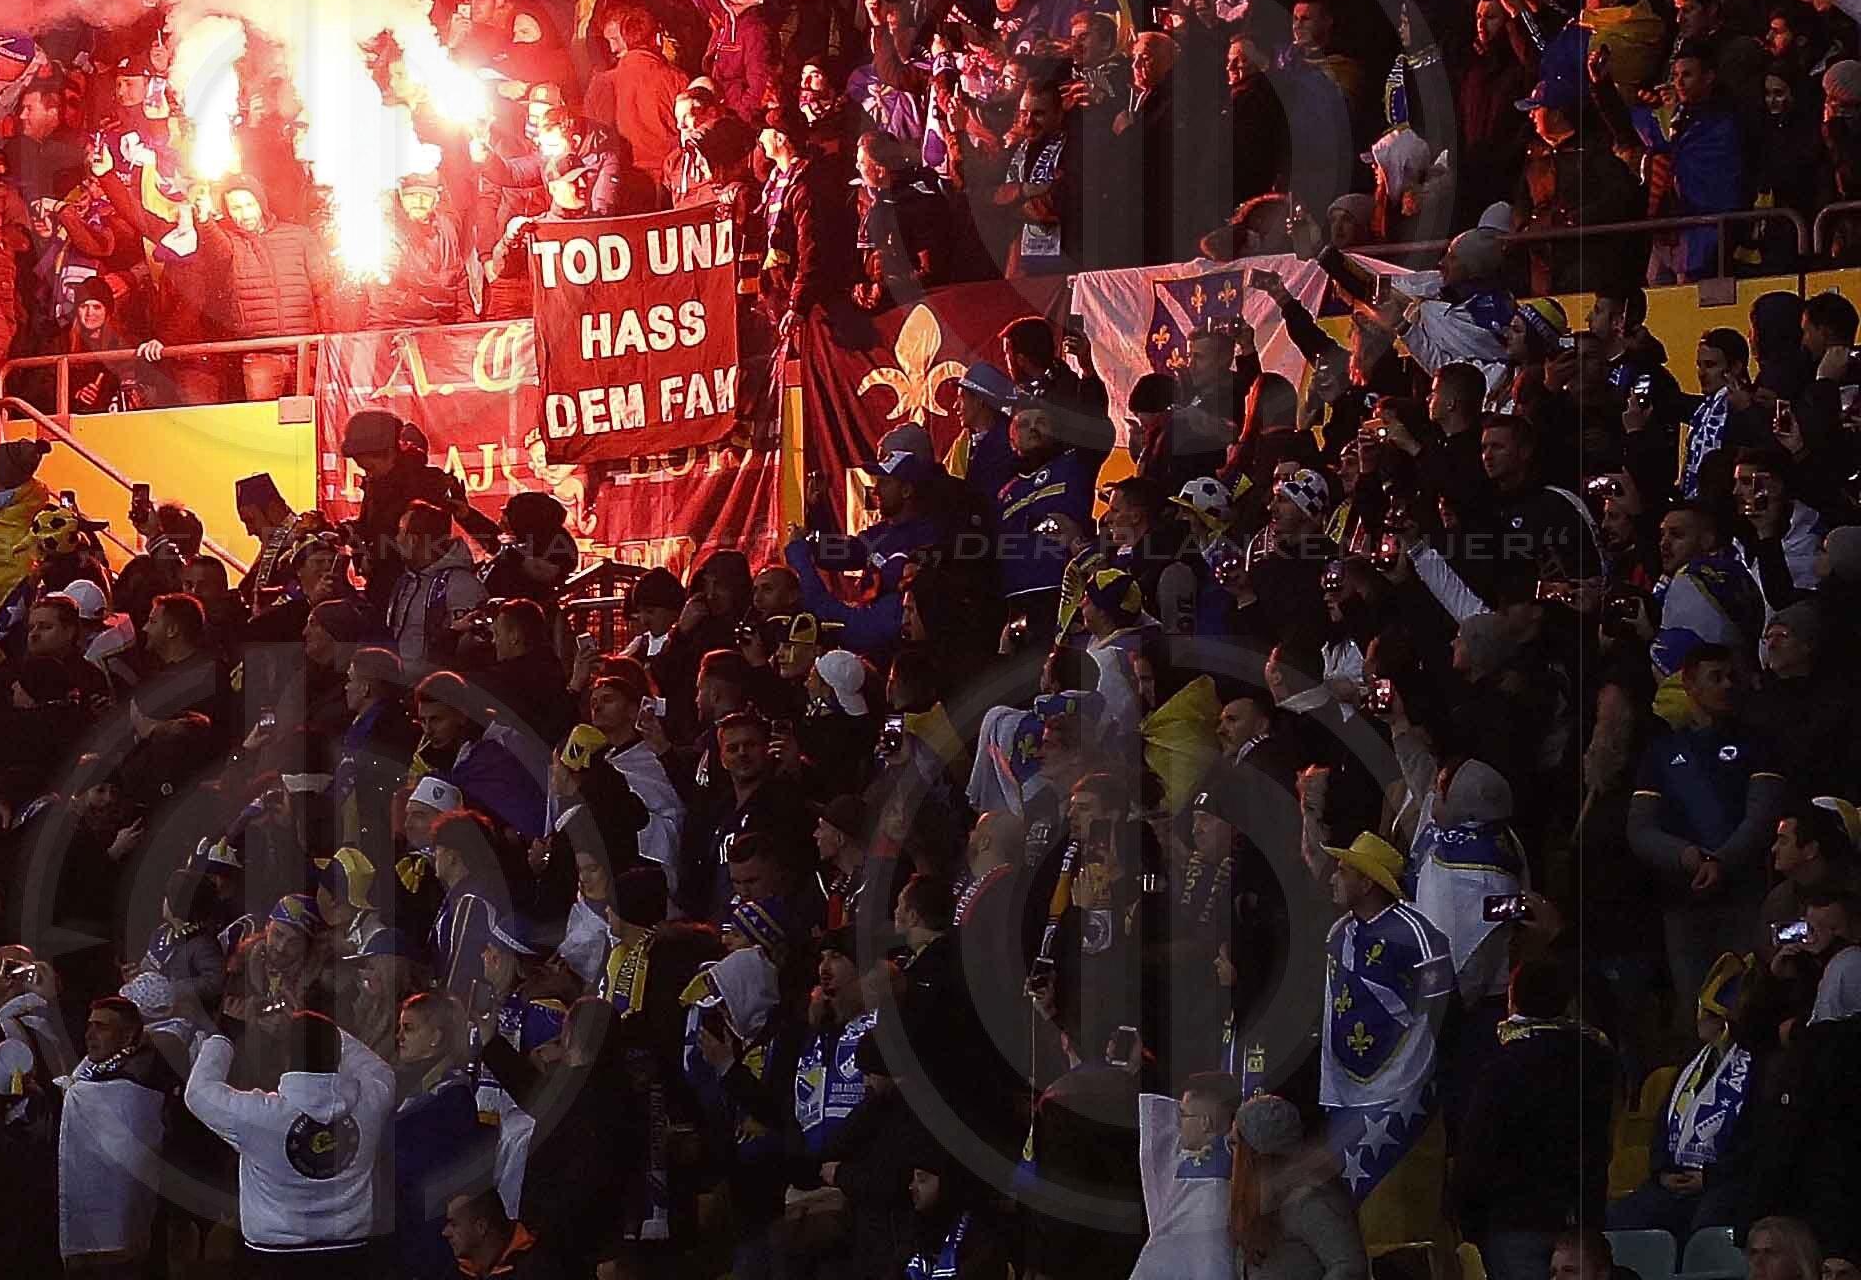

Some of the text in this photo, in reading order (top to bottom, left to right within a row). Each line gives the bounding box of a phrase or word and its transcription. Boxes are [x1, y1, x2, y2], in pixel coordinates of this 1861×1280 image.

[532, 219, 735, 289] TOD UND
[580, 300, 708, 361] HASS
[545, 383, 646, 440] DEM
